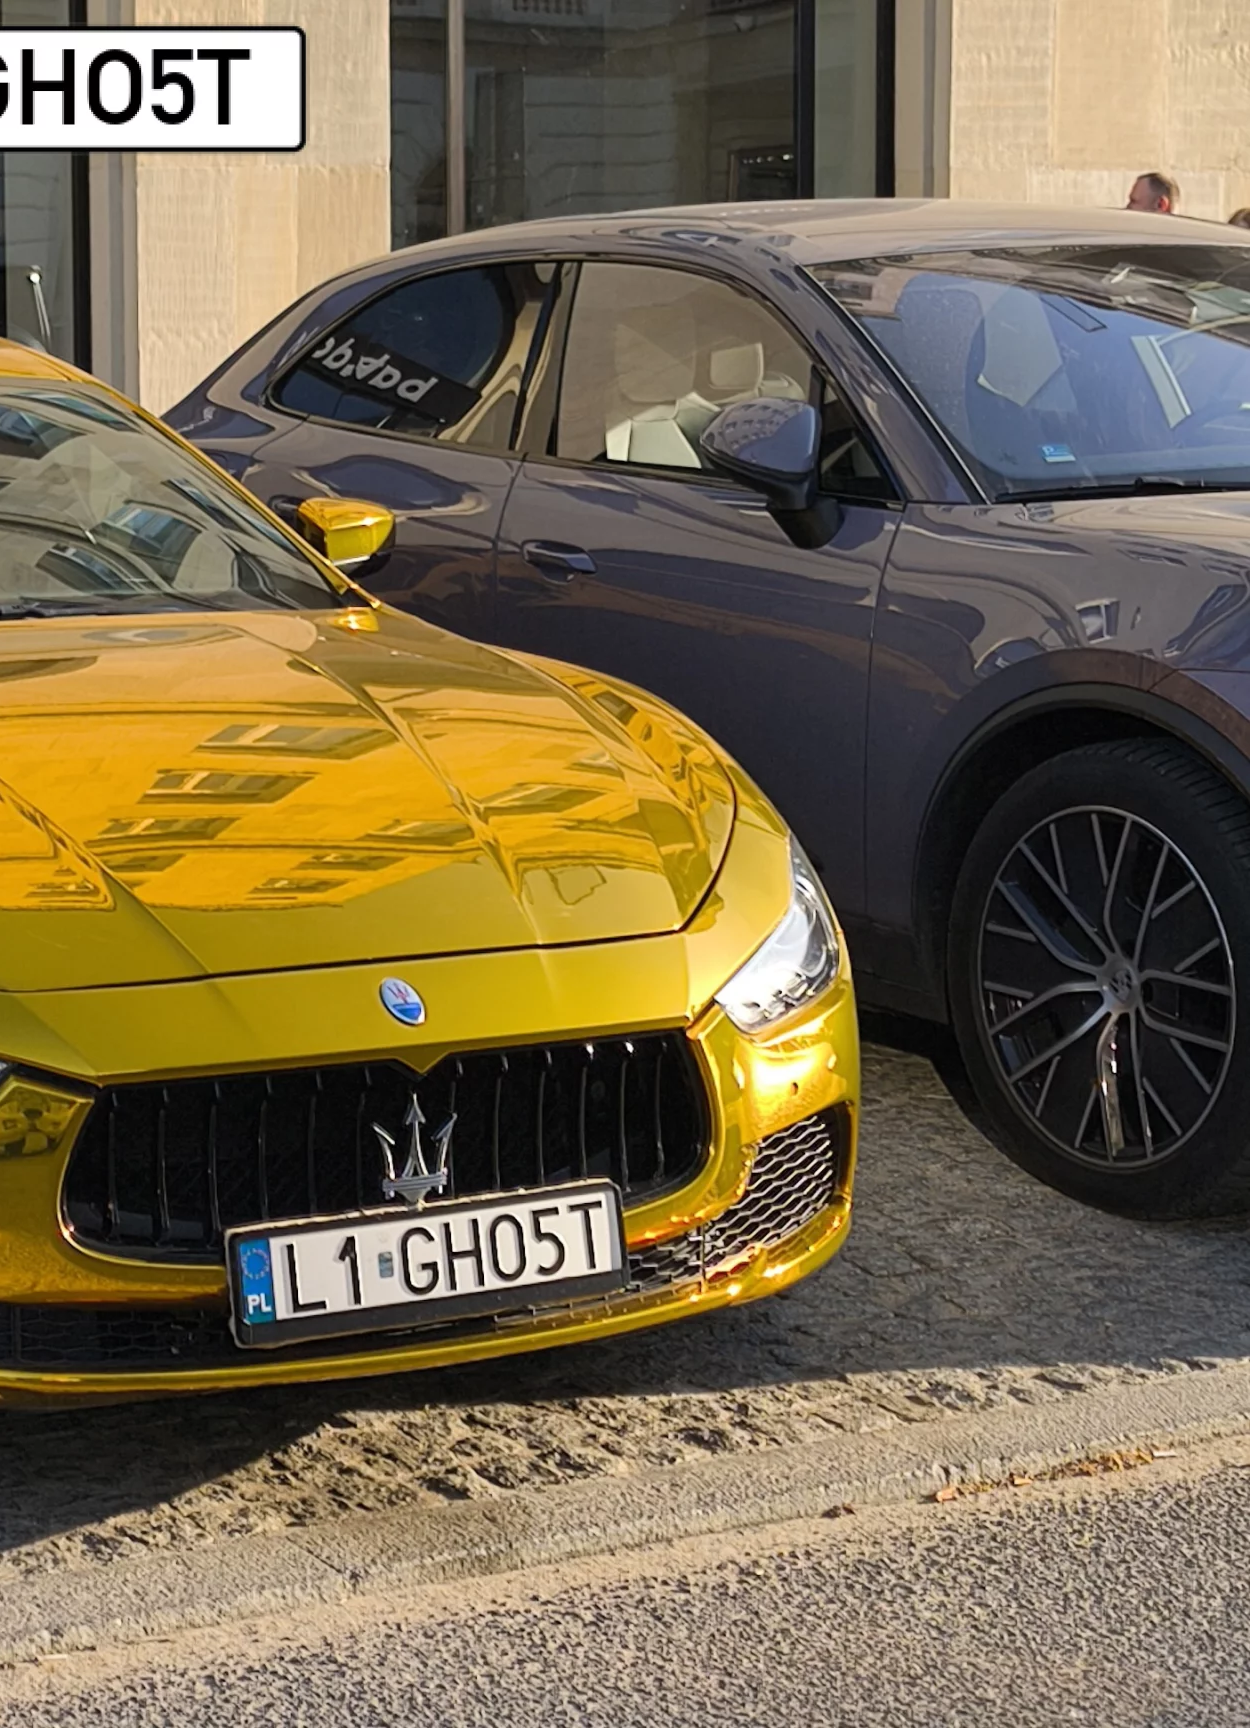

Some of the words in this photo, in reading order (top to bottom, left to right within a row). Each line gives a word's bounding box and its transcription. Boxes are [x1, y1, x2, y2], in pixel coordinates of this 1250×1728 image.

[285, 1235, 362, 1314] L1
[401, 1201, 602, 1295] GHO5T
[247, 1293, 272, 1314] PL
